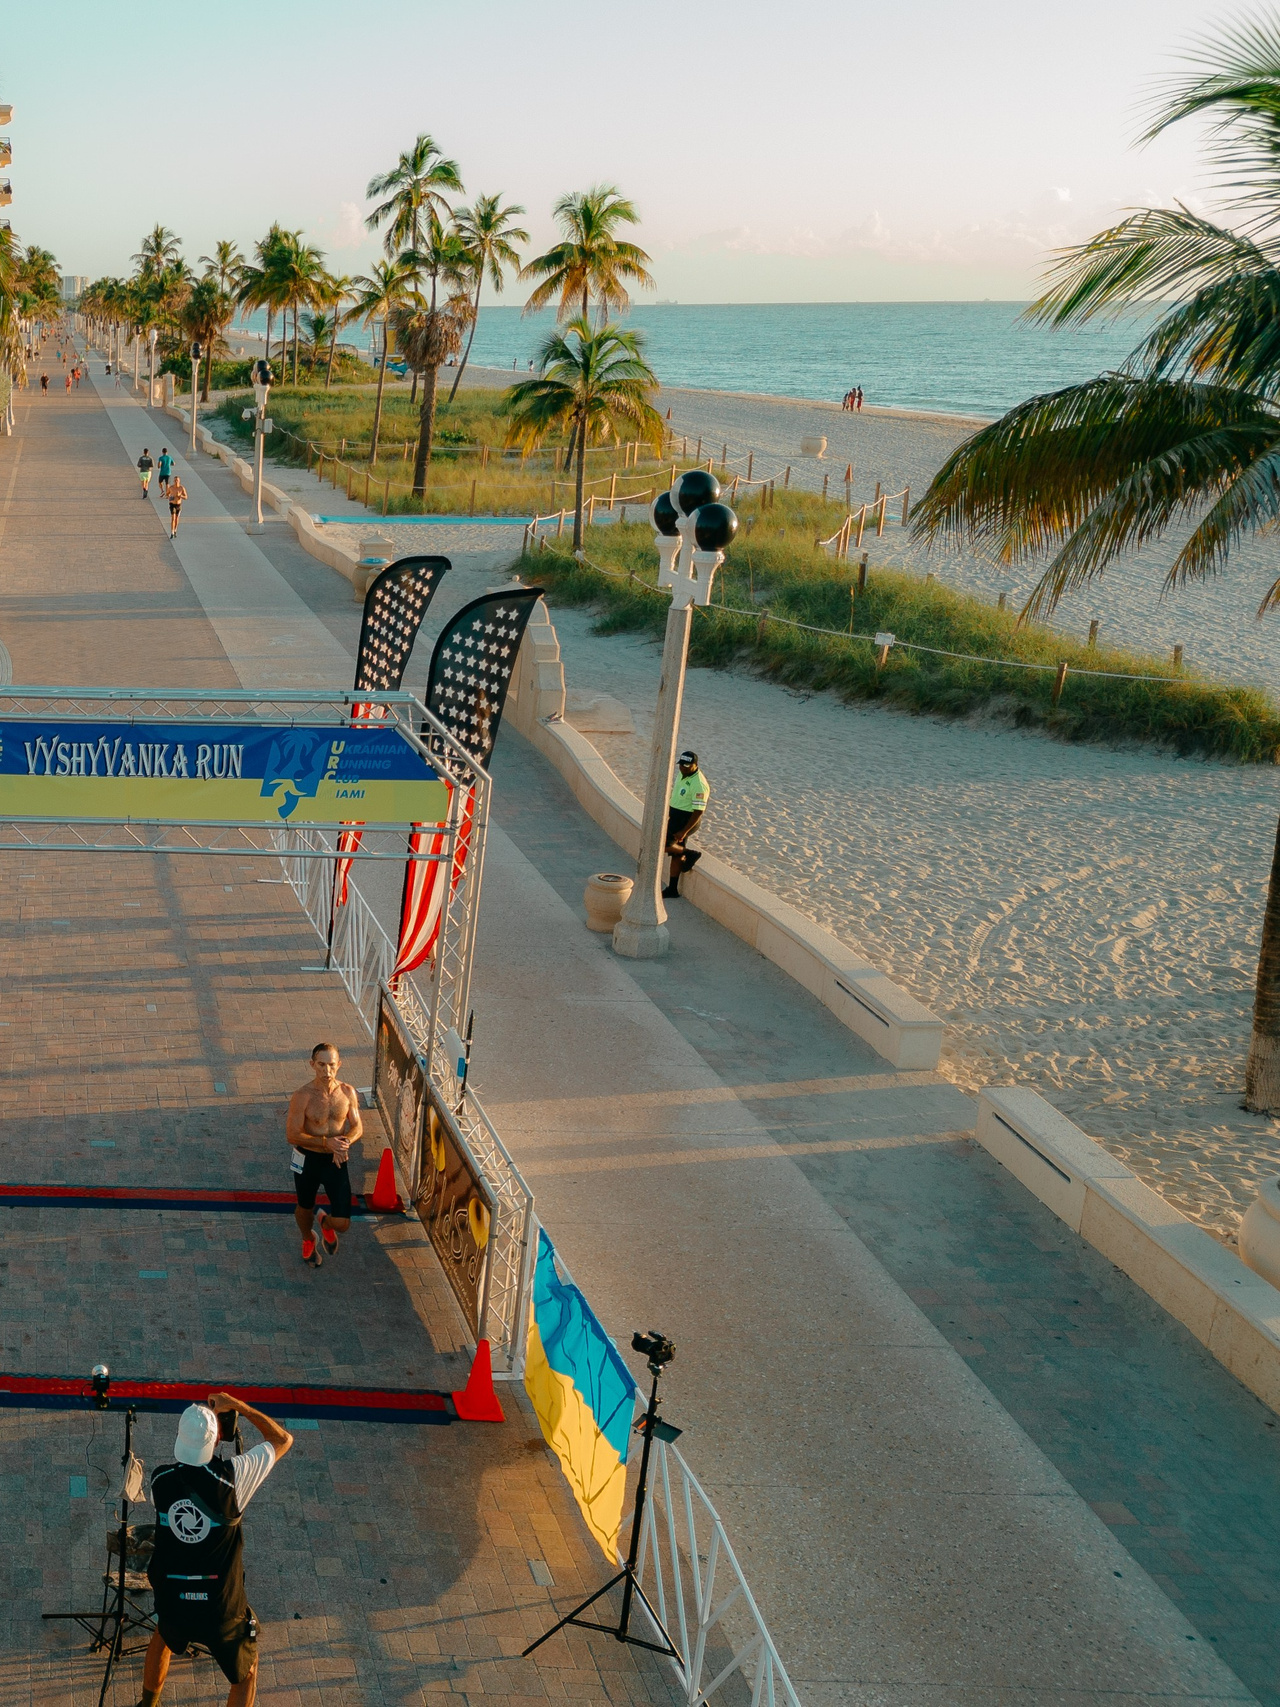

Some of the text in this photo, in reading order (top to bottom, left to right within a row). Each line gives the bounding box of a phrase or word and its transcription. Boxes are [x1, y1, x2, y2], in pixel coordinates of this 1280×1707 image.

[331, 741, 407, 754] UKRAINIAN
[24, 735, 244, 781] VYSHYVANKA RUN
[327, 756, 391, 769] RUNNING
[333, 789, 366, 799] IAMI
